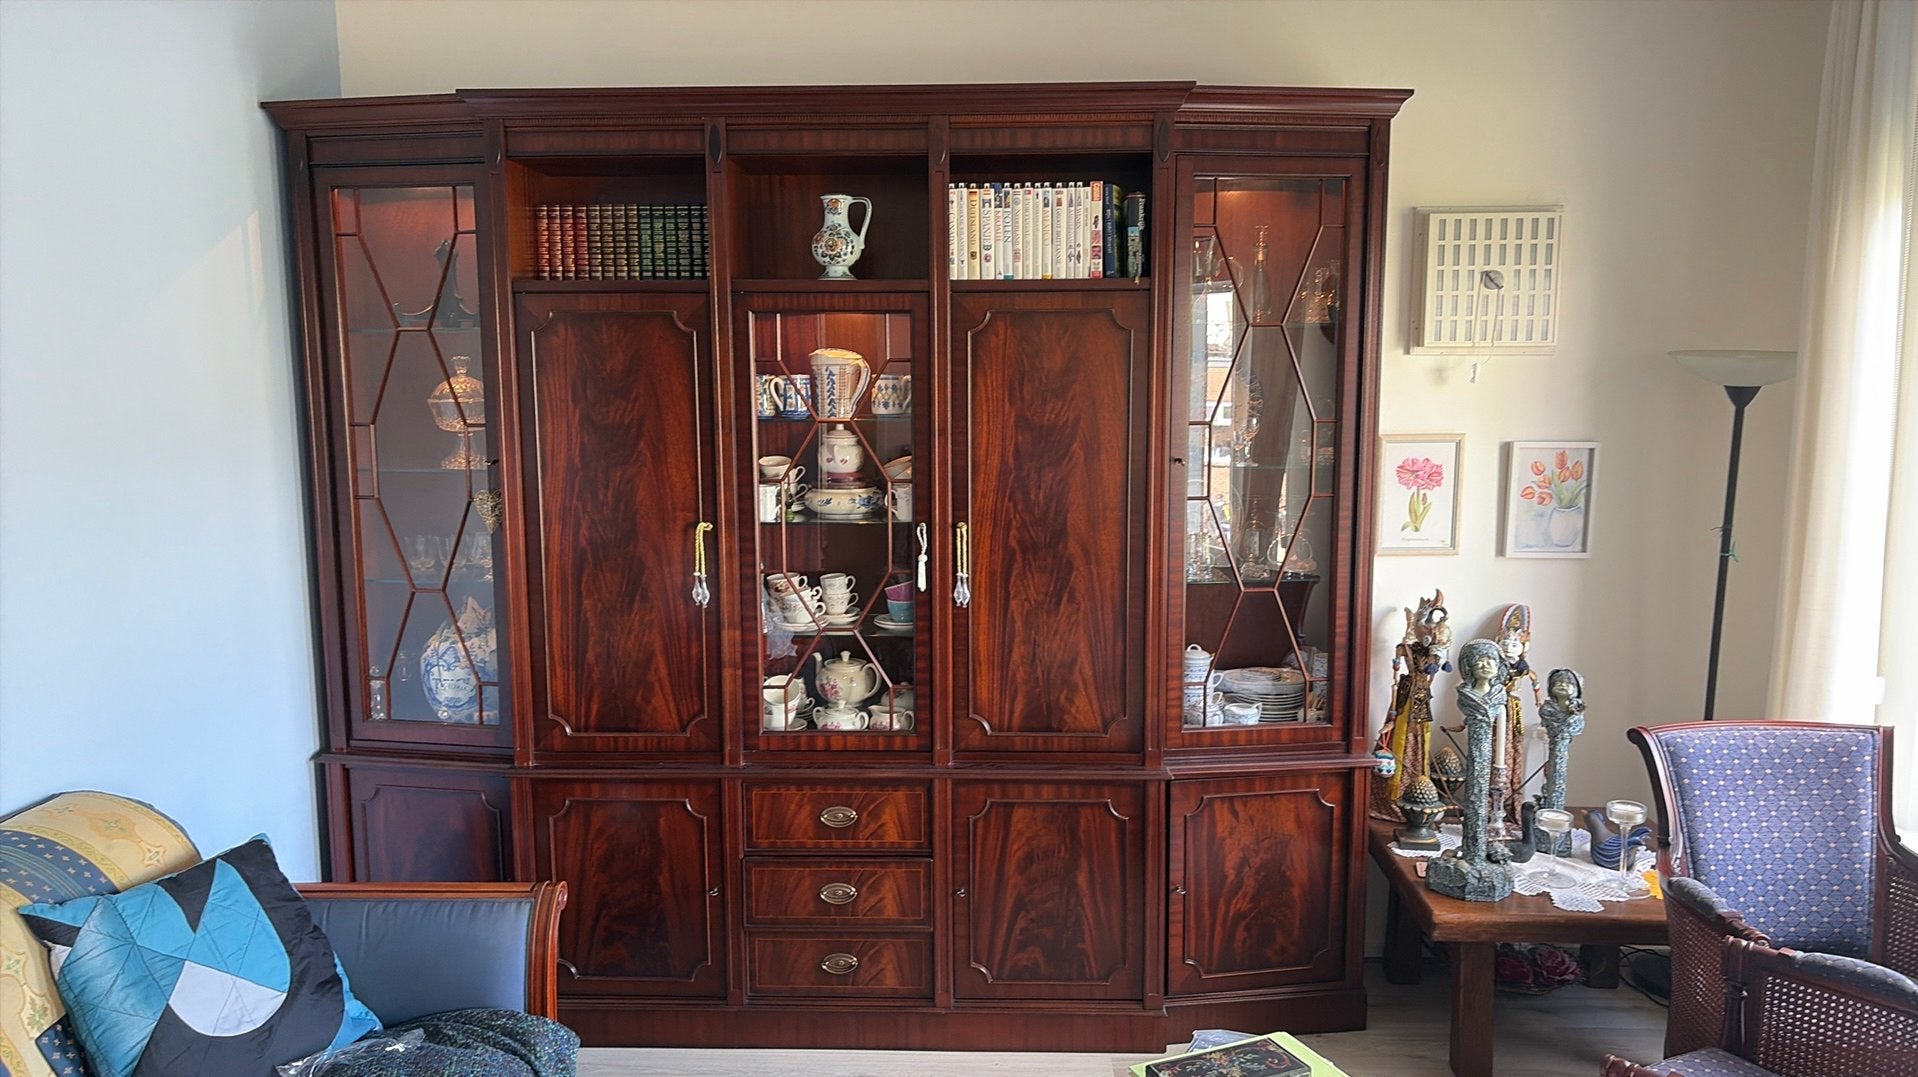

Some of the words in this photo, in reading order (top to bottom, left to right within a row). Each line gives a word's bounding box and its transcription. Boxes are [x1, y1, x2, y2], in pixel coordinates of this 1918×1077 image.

[983, 209, 992, 244] SPANJE
[1003, 210, 1011, 243] POLEN
[1137, 197, 1146, 230] Frankrijk
